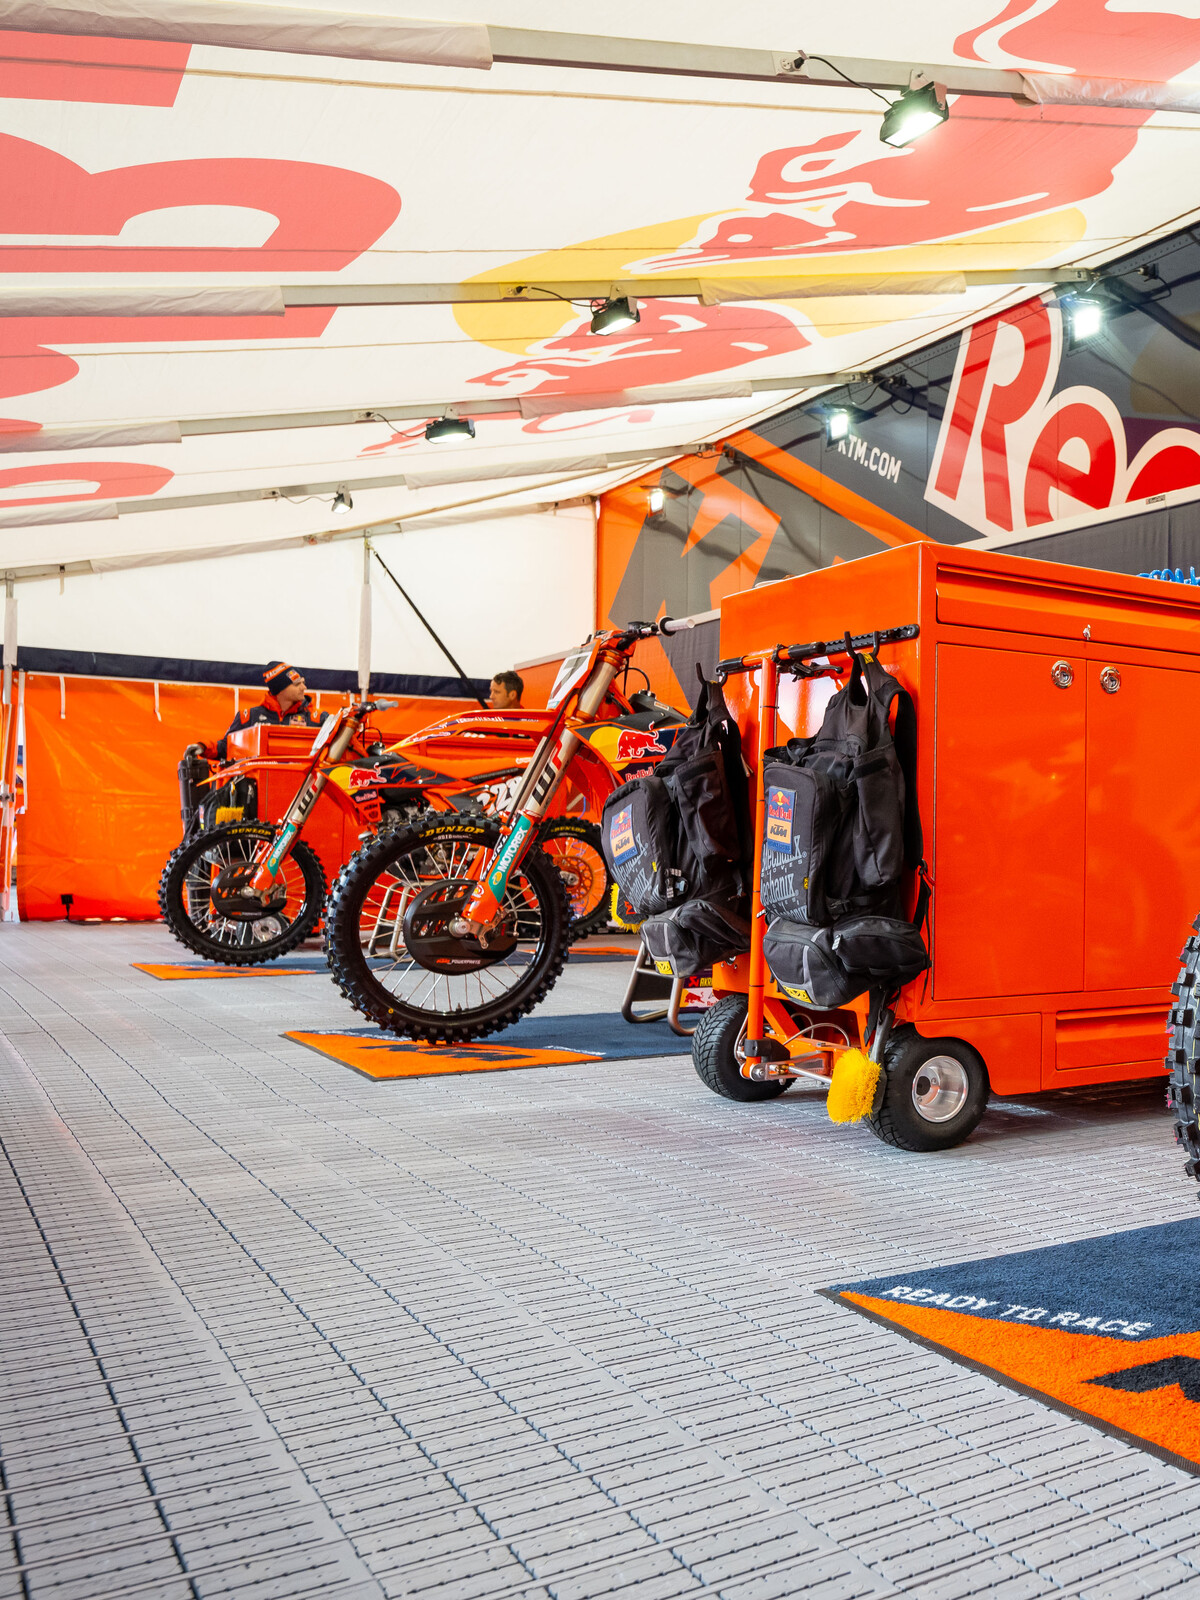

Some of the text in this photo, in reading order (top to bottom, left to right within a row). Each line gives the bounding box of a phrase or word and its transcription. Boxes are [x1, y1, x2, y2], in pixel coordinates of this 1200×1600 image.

[838, 434, 902, 484] KTM.COM
[625, 770, 640, 782] Red
[769, 804, 792, 821] Red Bull
[231, 828, 271, 836] DUNLOP
[425, 825, 485, 838] DUNLOP
[770, 824, 787, 837] KTM
[497, 827, 527, 873] MOTOREX
[615, 836, 630, 852] KTM
[880, 1285, 1155, 1336] READY TO RACE
